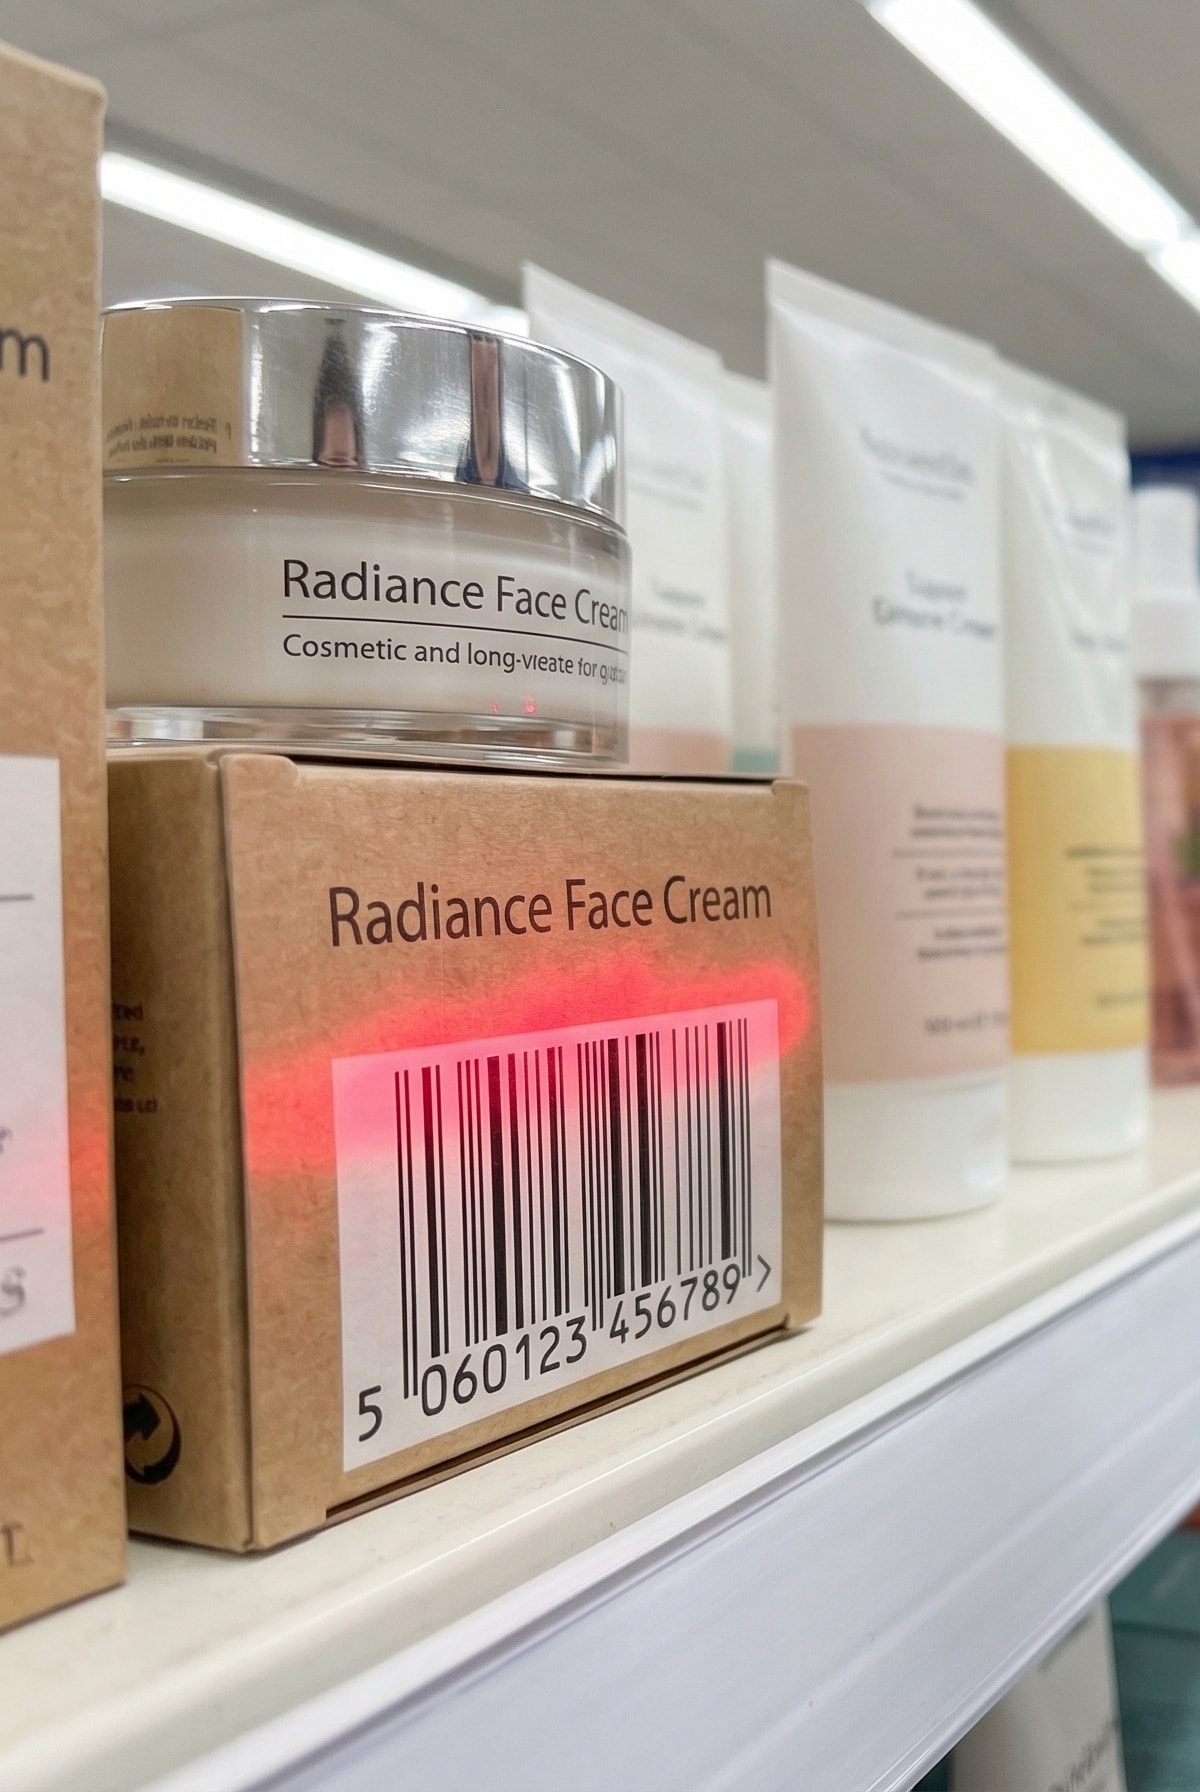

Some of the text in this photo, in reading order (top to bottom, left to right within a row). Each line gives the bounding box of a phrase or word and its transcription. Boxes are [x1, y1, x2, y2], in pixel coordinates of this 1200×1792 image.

[283, 559, 485, 609] Radiance
[497, 574, 567, 620] Face
[574, 588, 629, 635] Cream
[283, 633, 407, 661] Cosmetic
[414, 641, 460, 664] and
[577, 656, 597, 678] for
[329, 875, 773, 947] Radiance Face Cream
[358, 1385, 382, 1442] 5
[420, 1315, 588, 1417] 060123
[608, 1262, 742, 1344] 456789
